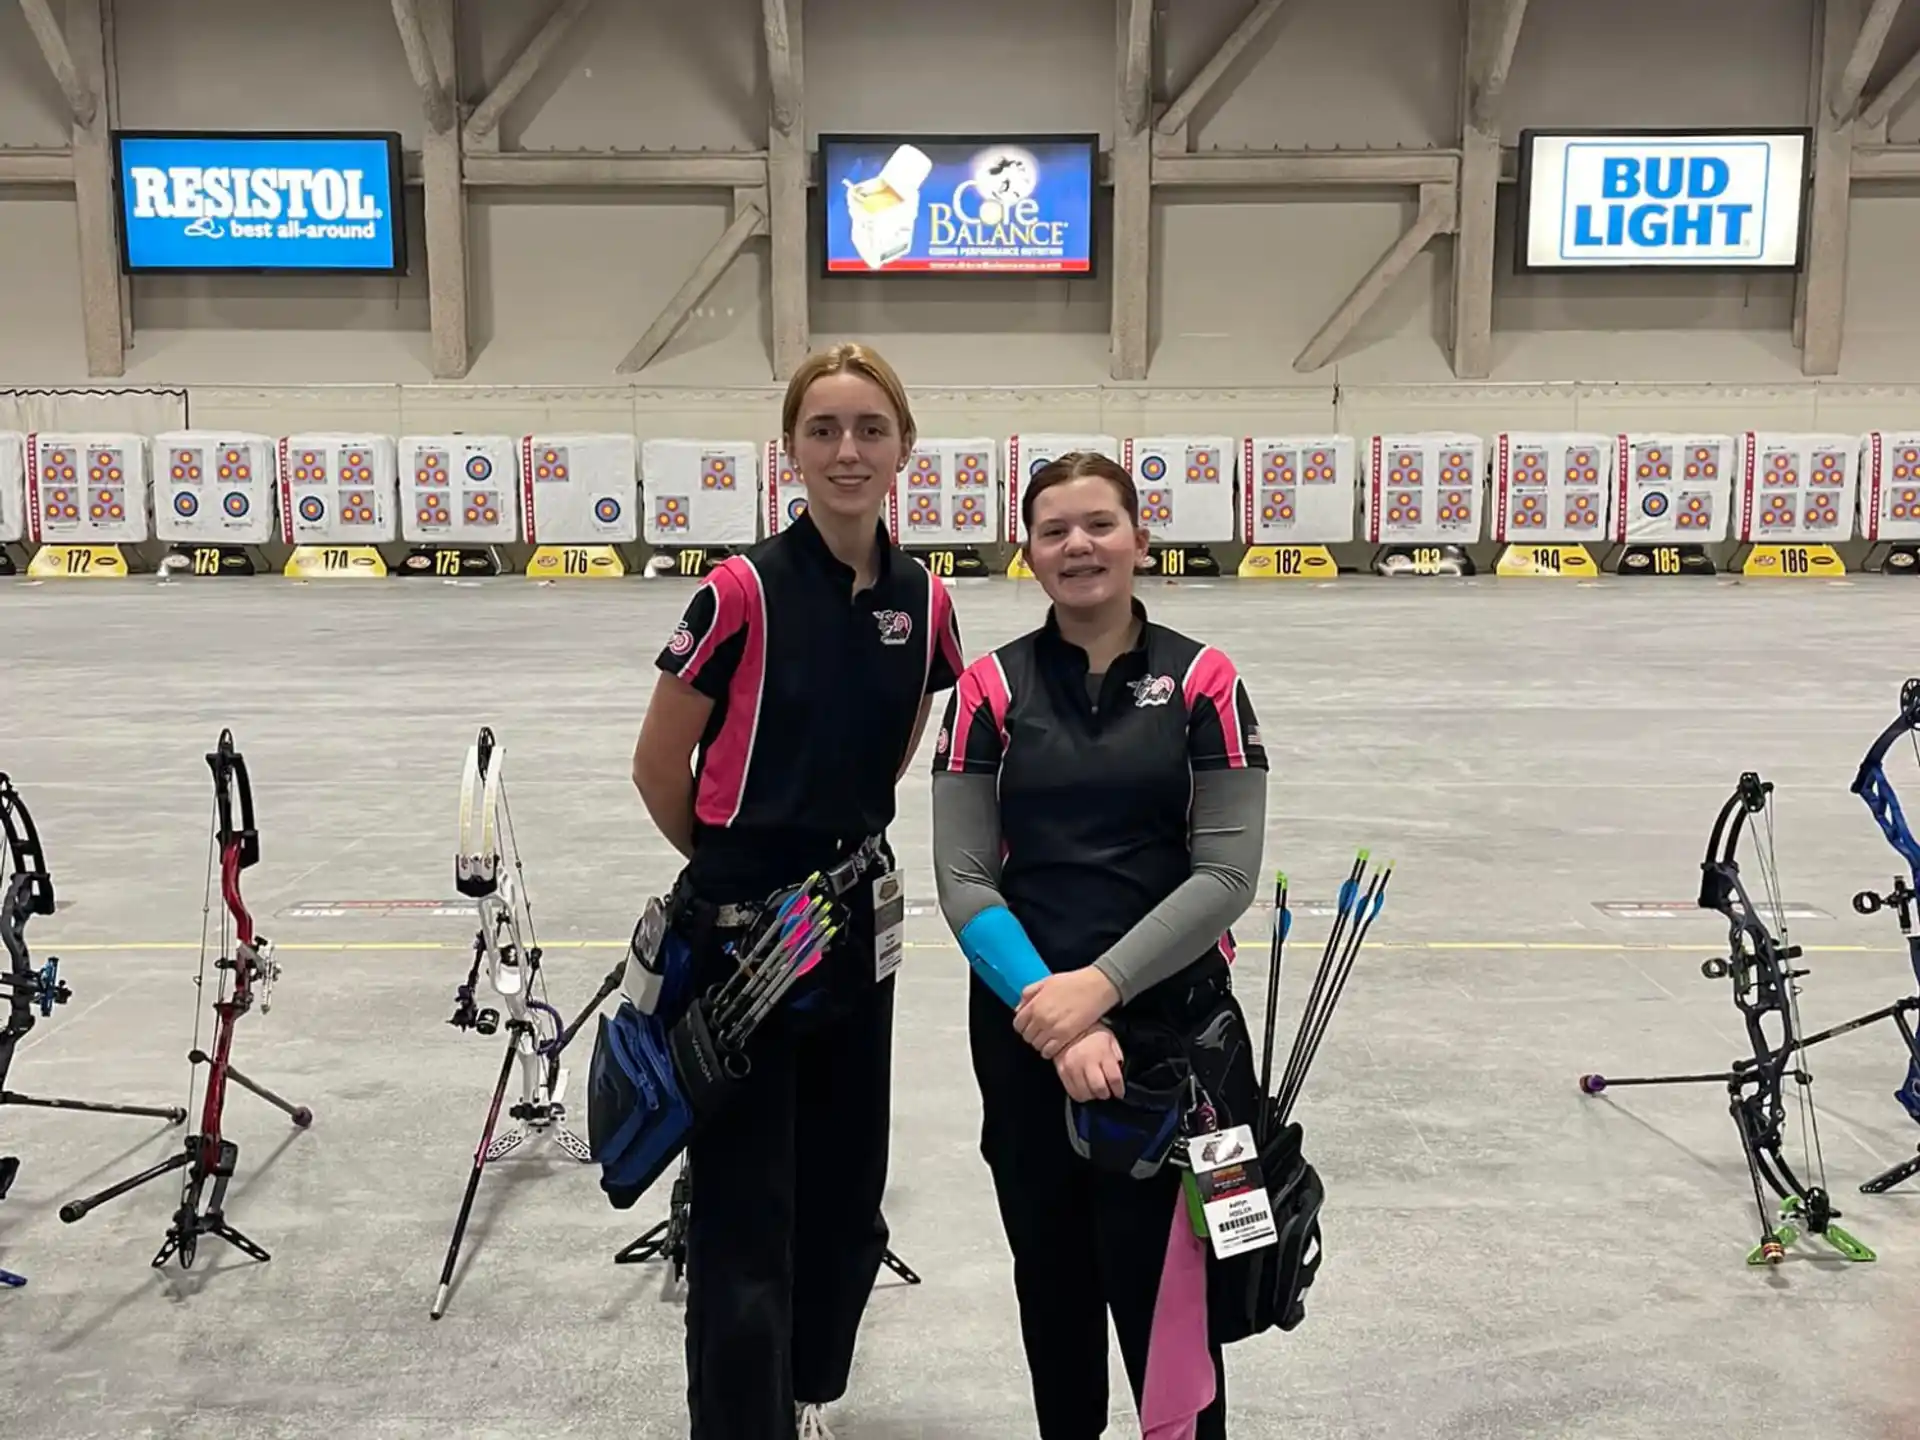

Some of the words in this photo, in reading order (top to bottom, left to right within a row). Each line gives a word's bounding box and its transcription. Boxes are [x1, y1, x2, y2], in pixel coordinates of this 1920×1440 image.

[1602, 157, 1730, 199] BUD
[231, 219, 272, 238] best
[277, 219, 376, 238] all-around
[1574, 204, 1752, 247] LIGHT
[67, 549, 91, 574] 172
[194, 549, 219, 574] 173
[435, 550, 460, 575] 175
[563, 549, 588, 574] 176
[680, 549, 703, 575] 177
[929, 551, 954, 575] 179
[1160, 549, 1184, 574] 181
[1275, 549, 1301, 574] 182
[1412, 548, 1441, 575] 183
[1652, 548, 1680, 574] 185
[1780, 548, 1808, 573] 186
